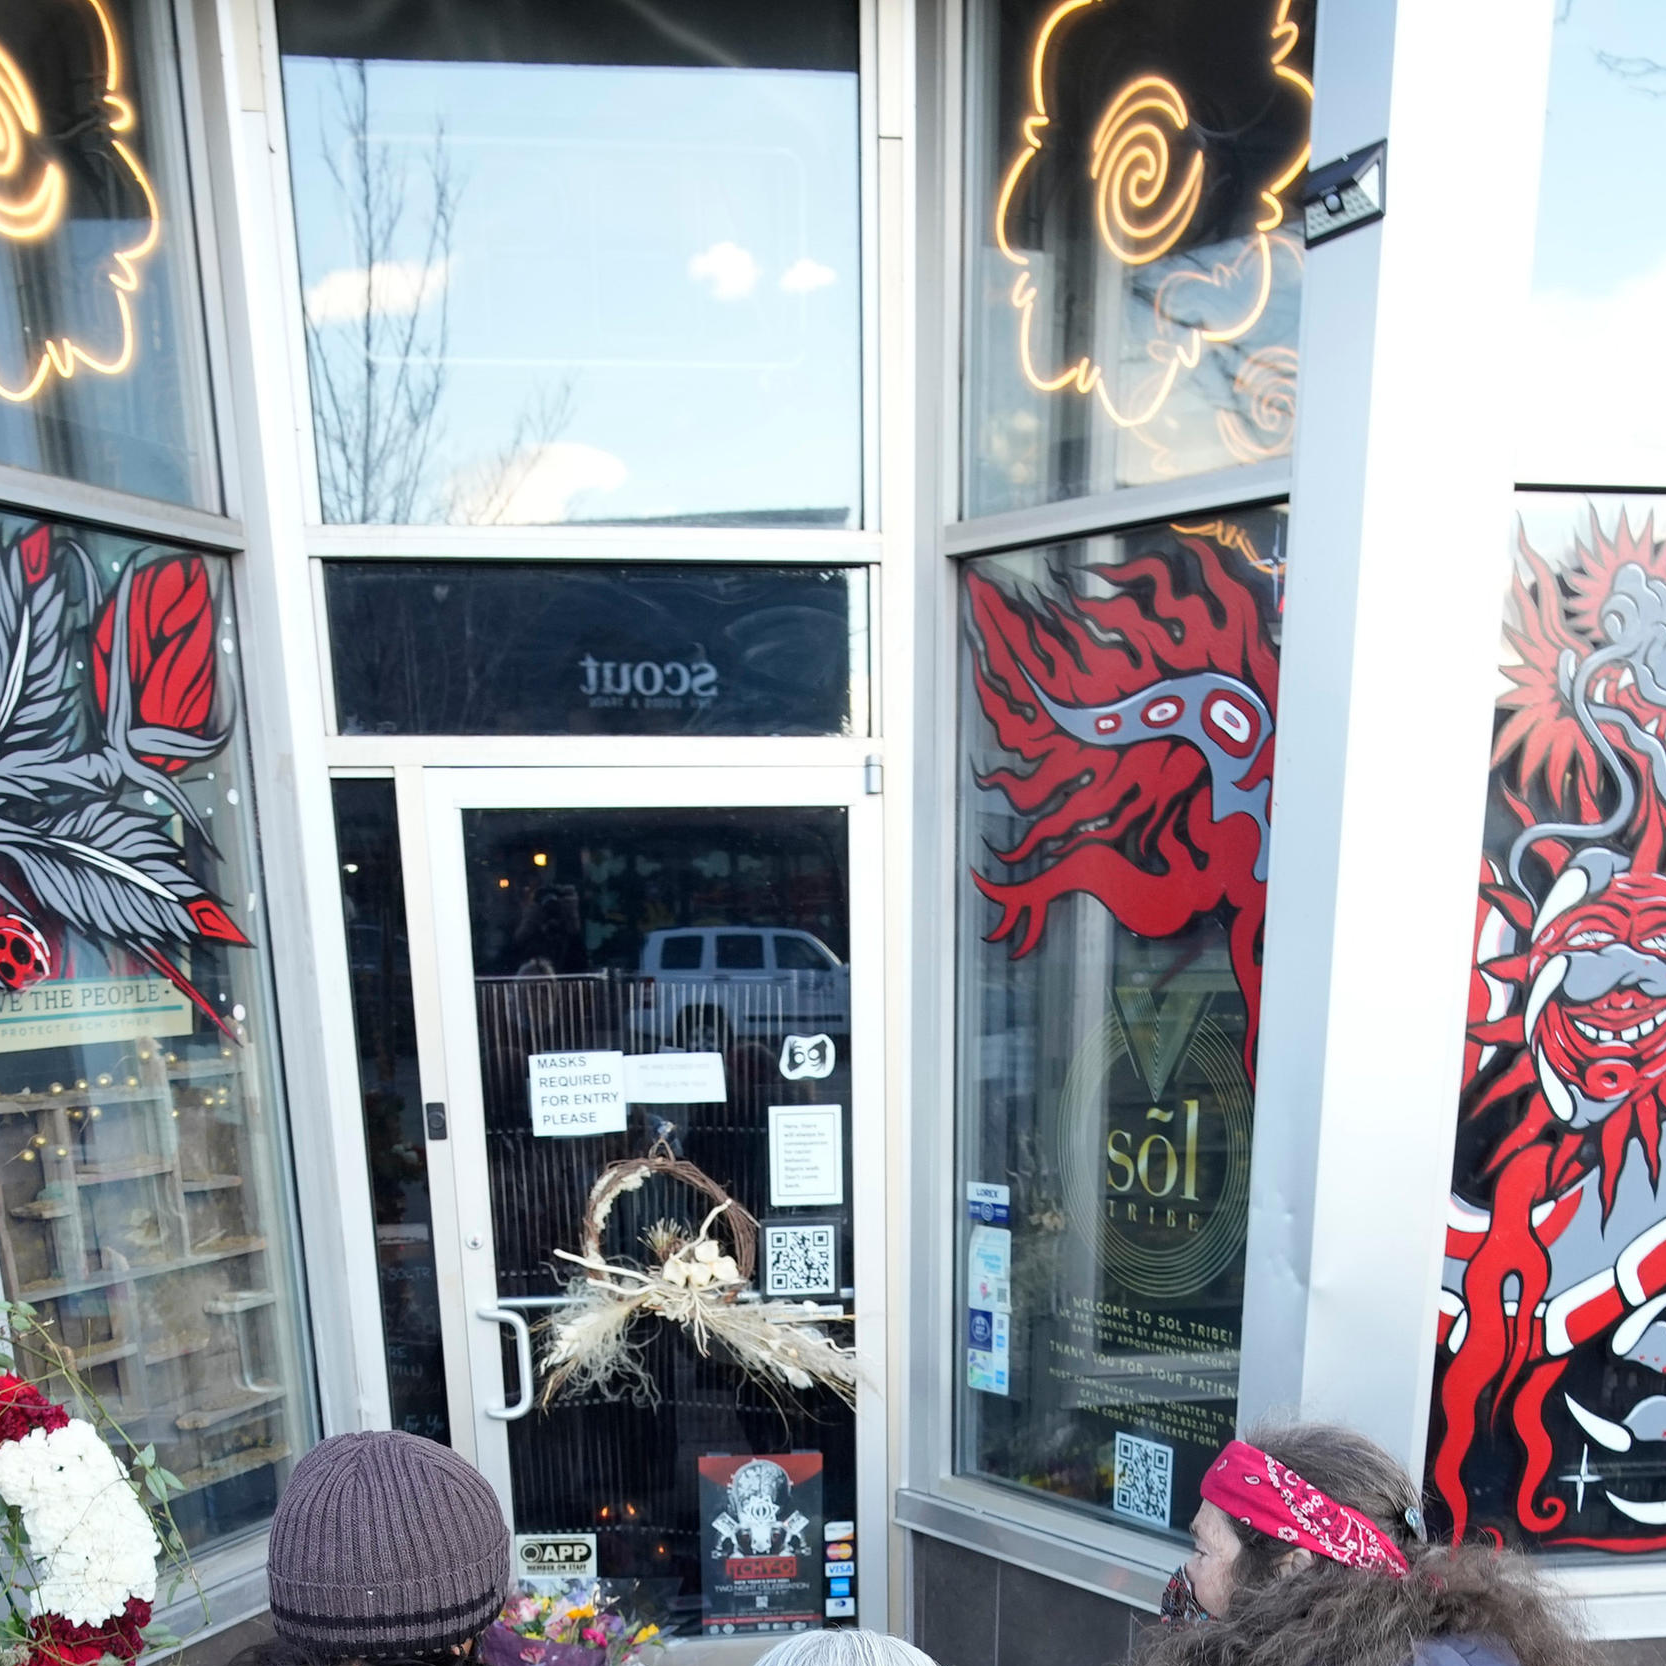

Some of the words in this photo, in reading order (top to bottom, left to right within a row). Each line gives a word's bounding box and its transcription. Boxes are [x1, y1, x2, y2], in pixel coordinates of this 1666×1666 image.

[31, 988, 75, 1010] THE
[82, 984, 161, 1008] PEOPLE
[1, 1023, 62, 1038] PROTECT
[69, 1020, 103, 1032] EACH
[537, 1056, 587, 1069] MASKS
[539, 1073, 612, 1088] REQUIRED
[541, 1095, 569, 1107] FOR
[574, 1092, 619, 1105] ENTRY
[543, 1112, 597, 1125] PLEASE
[1108, 1200, 1200, 1232] TRIBE
[1073, 1297, 1129, 1320] WELCOME
[1135, 1310, 1152, 1325] TO
[1158, 1316, 1183, 1332] SOL
[1189, 1322, 1233, 1343] TRIBE!
[1094, 1317, 1134, 1334] WORKING
[1137, 1326, 1148, 1337] BY
[1152, 1331, 1219, 1353] APPOINTMENT
[1097, 1330, 1113, 1341] DAY
[1049, 1340, 1086, 1360] THANK
[1092, 1351, 1115, 1367] YOU
[1119, 1358, 1144, 1375] FOR
[1150, 1366, 1184, 1386] YOUR
[1189, 1375, 1238, 1399] PATIEN
[1079, 1388, 1100, 1401] CALL
[1125, 1400, 1157, 1417] STUDIO
[1138, 1392, 1161, 1405] WITH
[1164, 1398, 1207, 1419] COUNTER
[1212, 1411, 1224, 1424] TO
[1102, 1407, 1125, 1421] CODE
[1128, 1414, 1145, 1427] FOR
[1193, 1433, 1220, 1449] FORM
[829, 1564, 852, 1573] VISA
[734, 1584, 756, 1592] NIGHT
[757, 1582, 810, 1591] CELEBRATION
